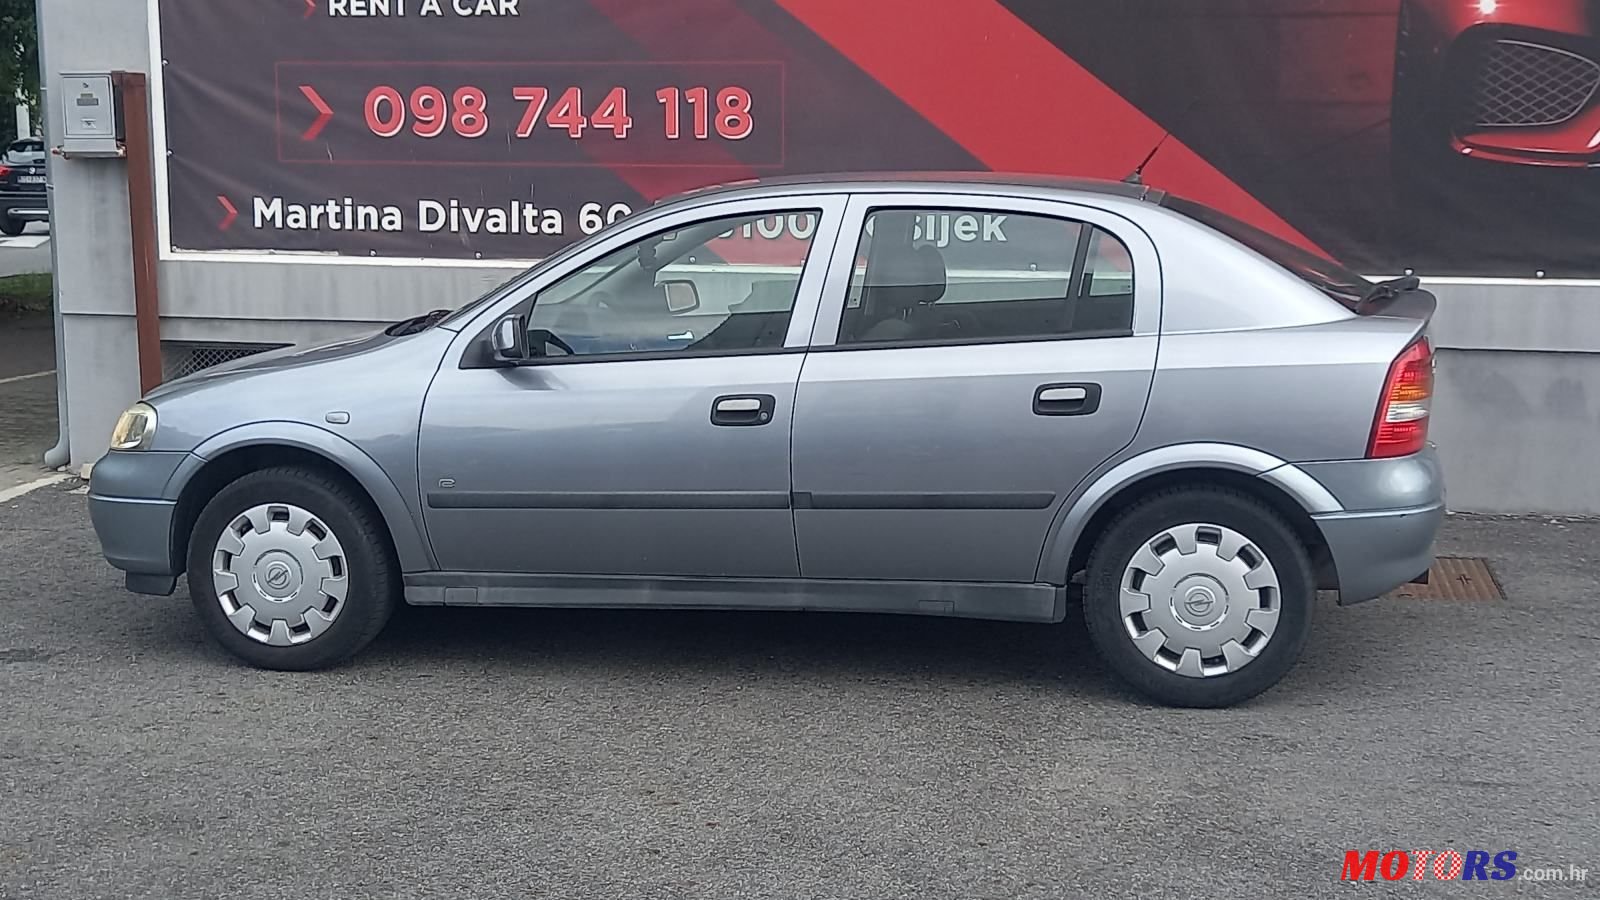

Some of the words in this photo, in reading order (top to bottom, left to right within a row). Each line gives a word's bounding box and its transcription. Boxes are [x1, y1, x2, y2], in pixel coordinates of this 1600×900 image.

[328, 0, 404, 16] RENT
[420, 0, 443, 16] A
[452, 0, 519, 16] CAR
[364, 85, 488, 137] 098
[512, 86, 632, 139] 744
[655, 86, 753, 139] 118
[253, 197, 402, 230] Martina
[418, 199, 563, 234] Divalta
